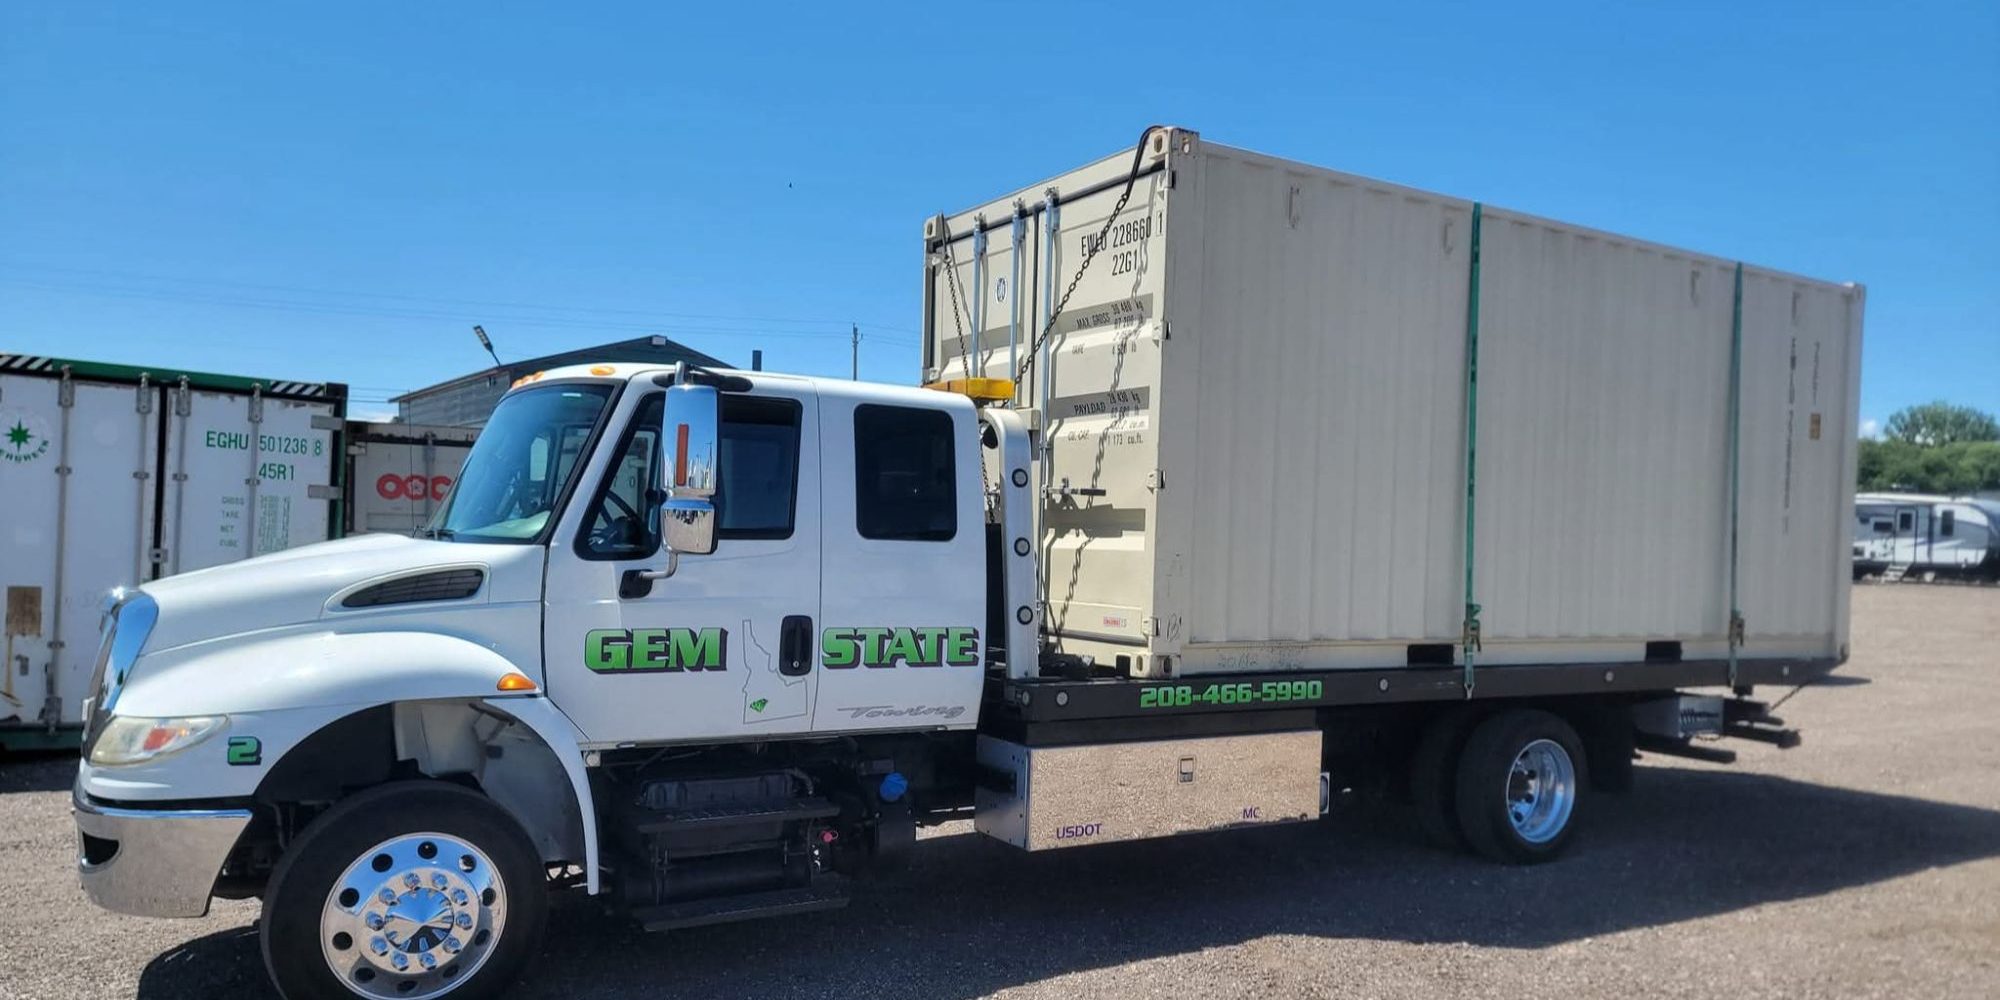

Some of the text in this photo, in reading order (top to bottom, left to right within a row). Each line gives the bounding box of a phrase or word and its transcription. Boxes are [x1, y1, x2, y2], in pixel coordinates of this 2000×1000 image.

[1112, 215, 1151, 248] 228660
[1112, 249, 1138, 276] 22G1
[1074, 401, 1106, 416] PAYLOAD
[205, 430, 322, 456] EGHU 501236 8
[258, 463, 294, 480] 45R1
[585, 627, 980, 674] GEM STATE
[1140, 680, 1323, 708] 208-466-5990
[837, 705, 966, 719] Towing
[227, 736, 262, 766] 2
[1243, 807, 1260, 820] MC
[1056, 823, 1103, 840] USDOT
